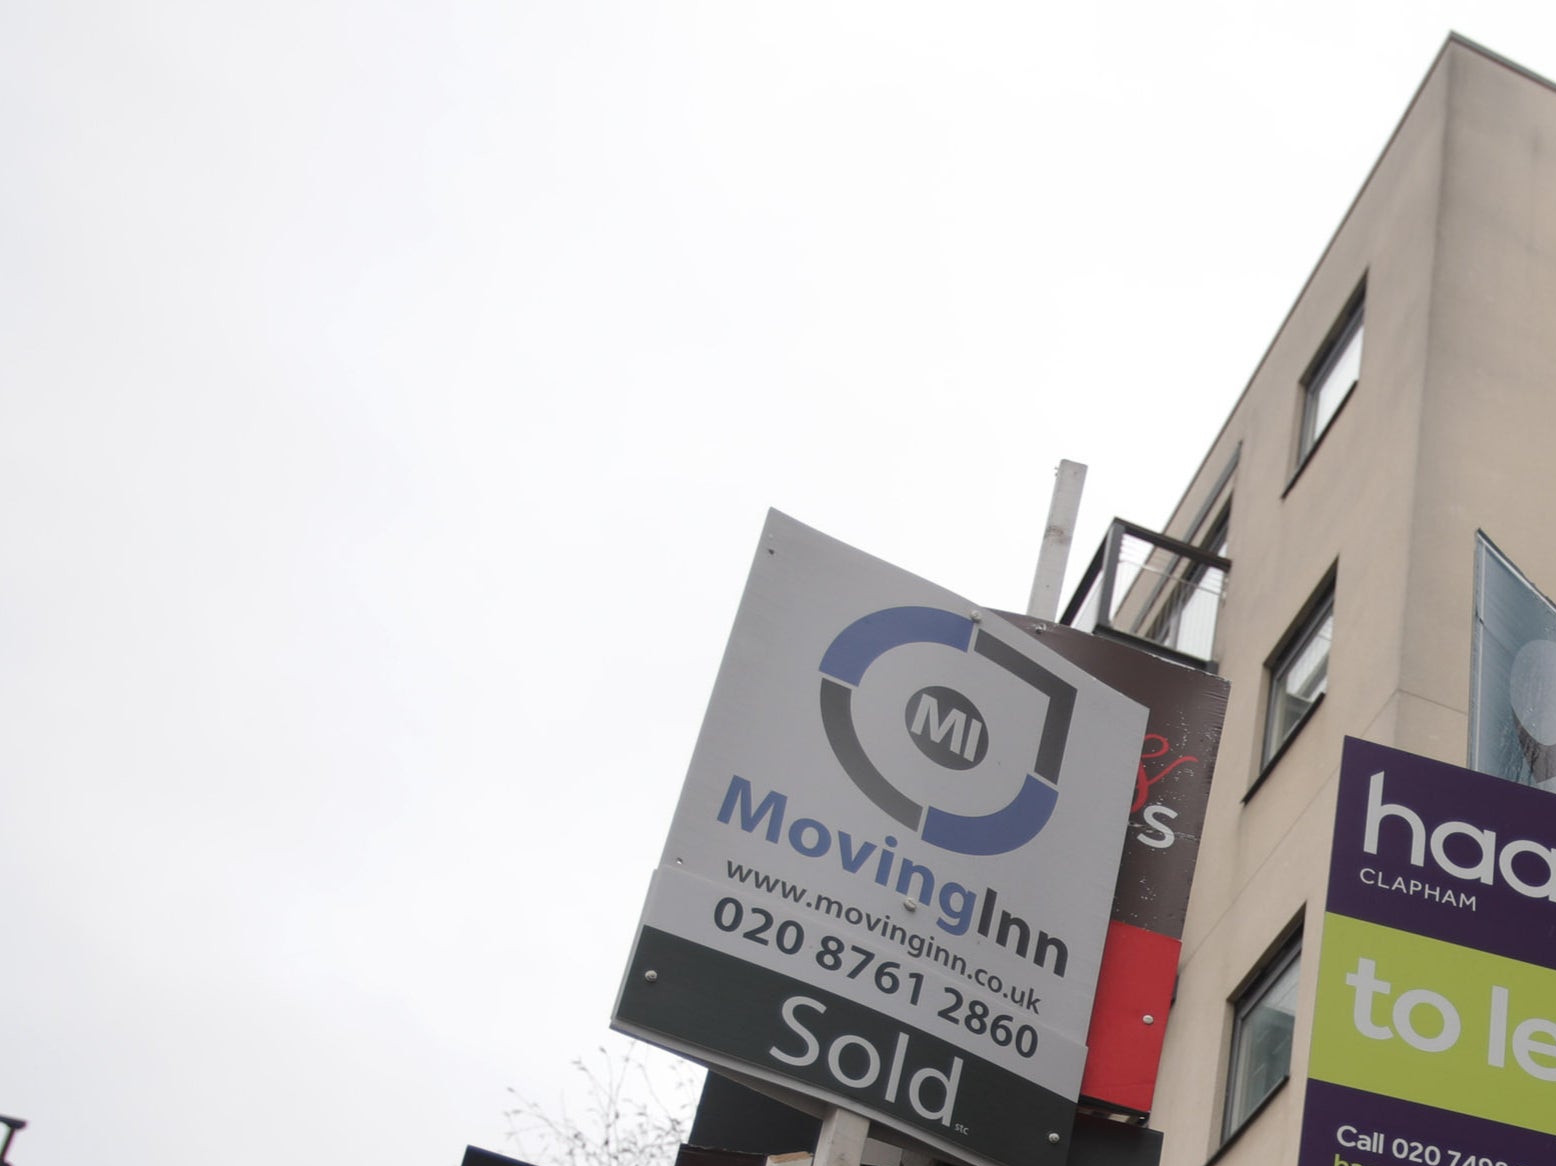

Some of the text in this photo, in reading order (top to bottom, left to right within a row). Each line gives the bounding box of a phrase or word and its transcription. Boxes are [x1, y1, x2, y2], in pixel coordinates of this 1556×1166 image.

[912, 693, 983, 762] MI
[717, 775, 1069, 978] MovingInn
[1359, 868, 1477, 912] CLAPHAM
[713, 896, 1038, 1058] 020 8761 2860
[725, 857, 1040, 1014] www.movinginn.co.uk
[769, 994, 965, 1127] Sold
[1345, 957, 1462, 1053] to
[1336, 1126, 1385, 1155] Call
[1392, 1138, 1441, 1166] 020
